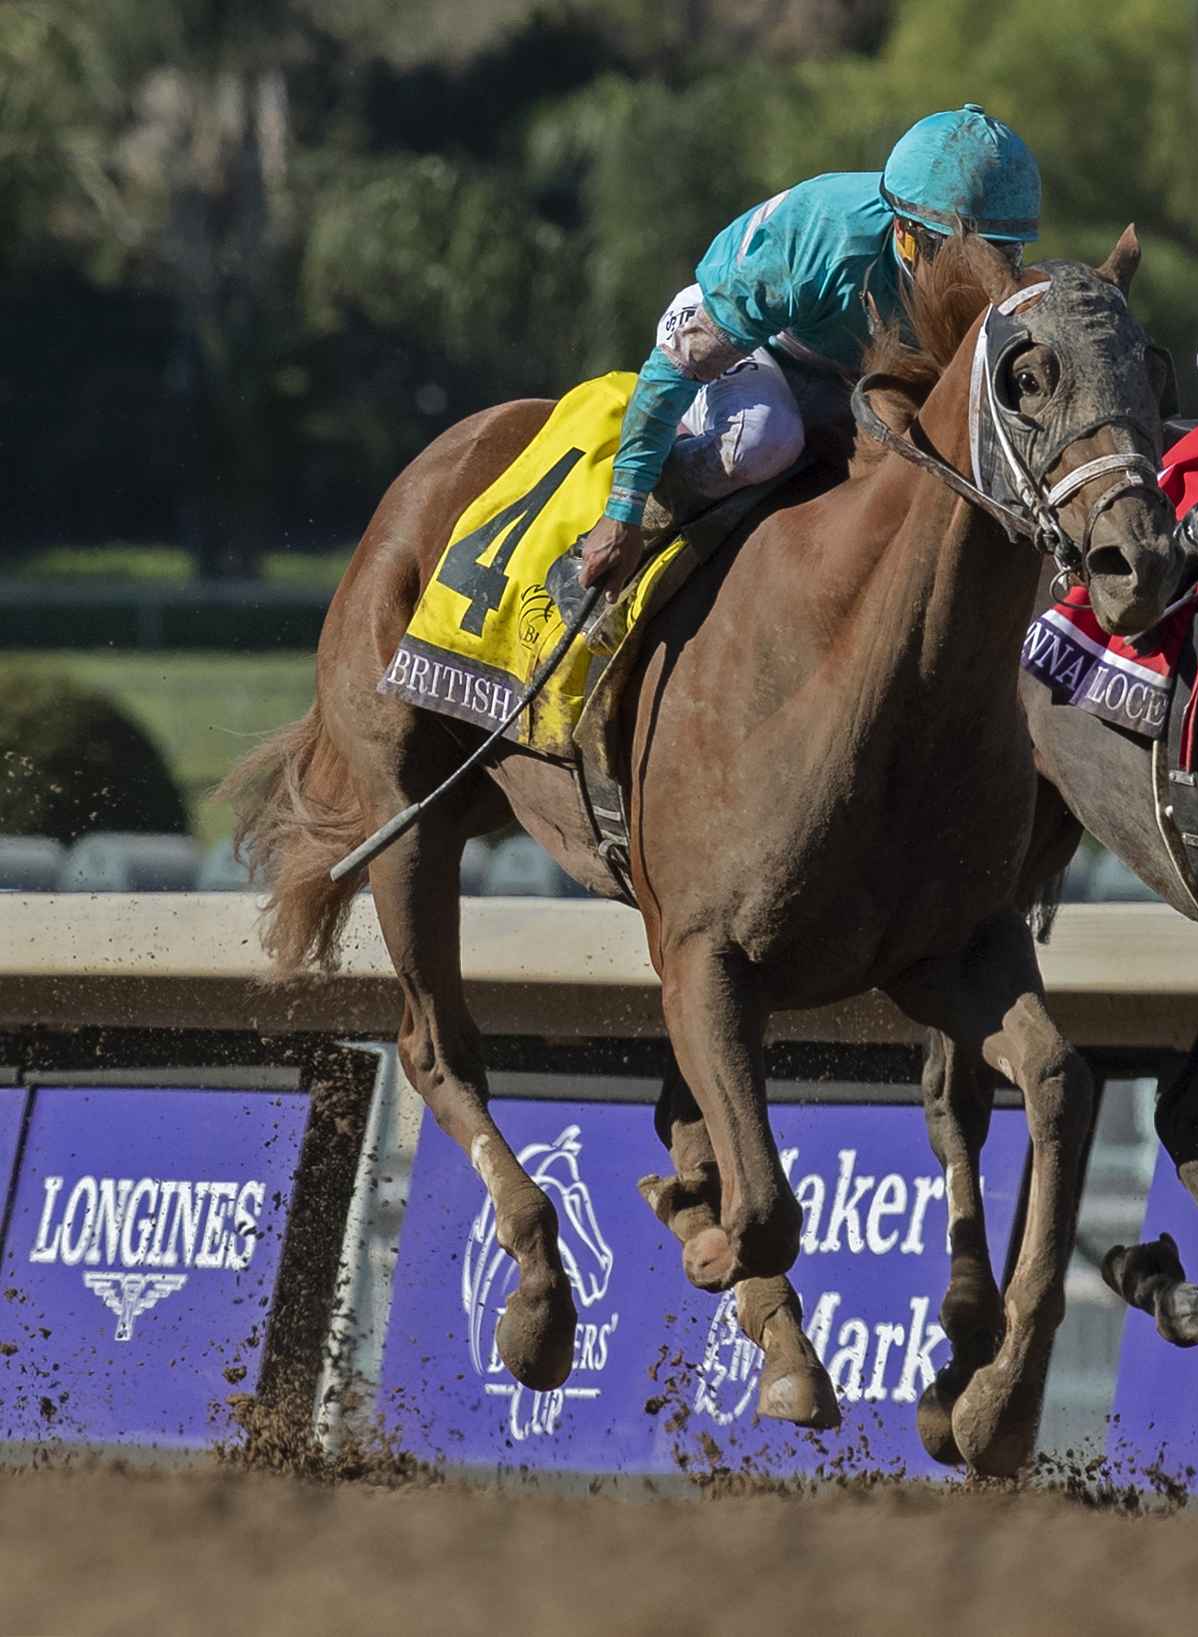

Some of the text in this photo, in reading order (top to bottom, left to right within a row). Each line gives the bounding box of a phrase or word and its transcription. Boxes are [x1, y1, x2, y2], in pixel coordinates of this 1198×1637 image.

[437, 446, 587, 639] 4
[385, 648, 513, 724] BRITISH
[29, 1175, 267, 1271] LONGINES
